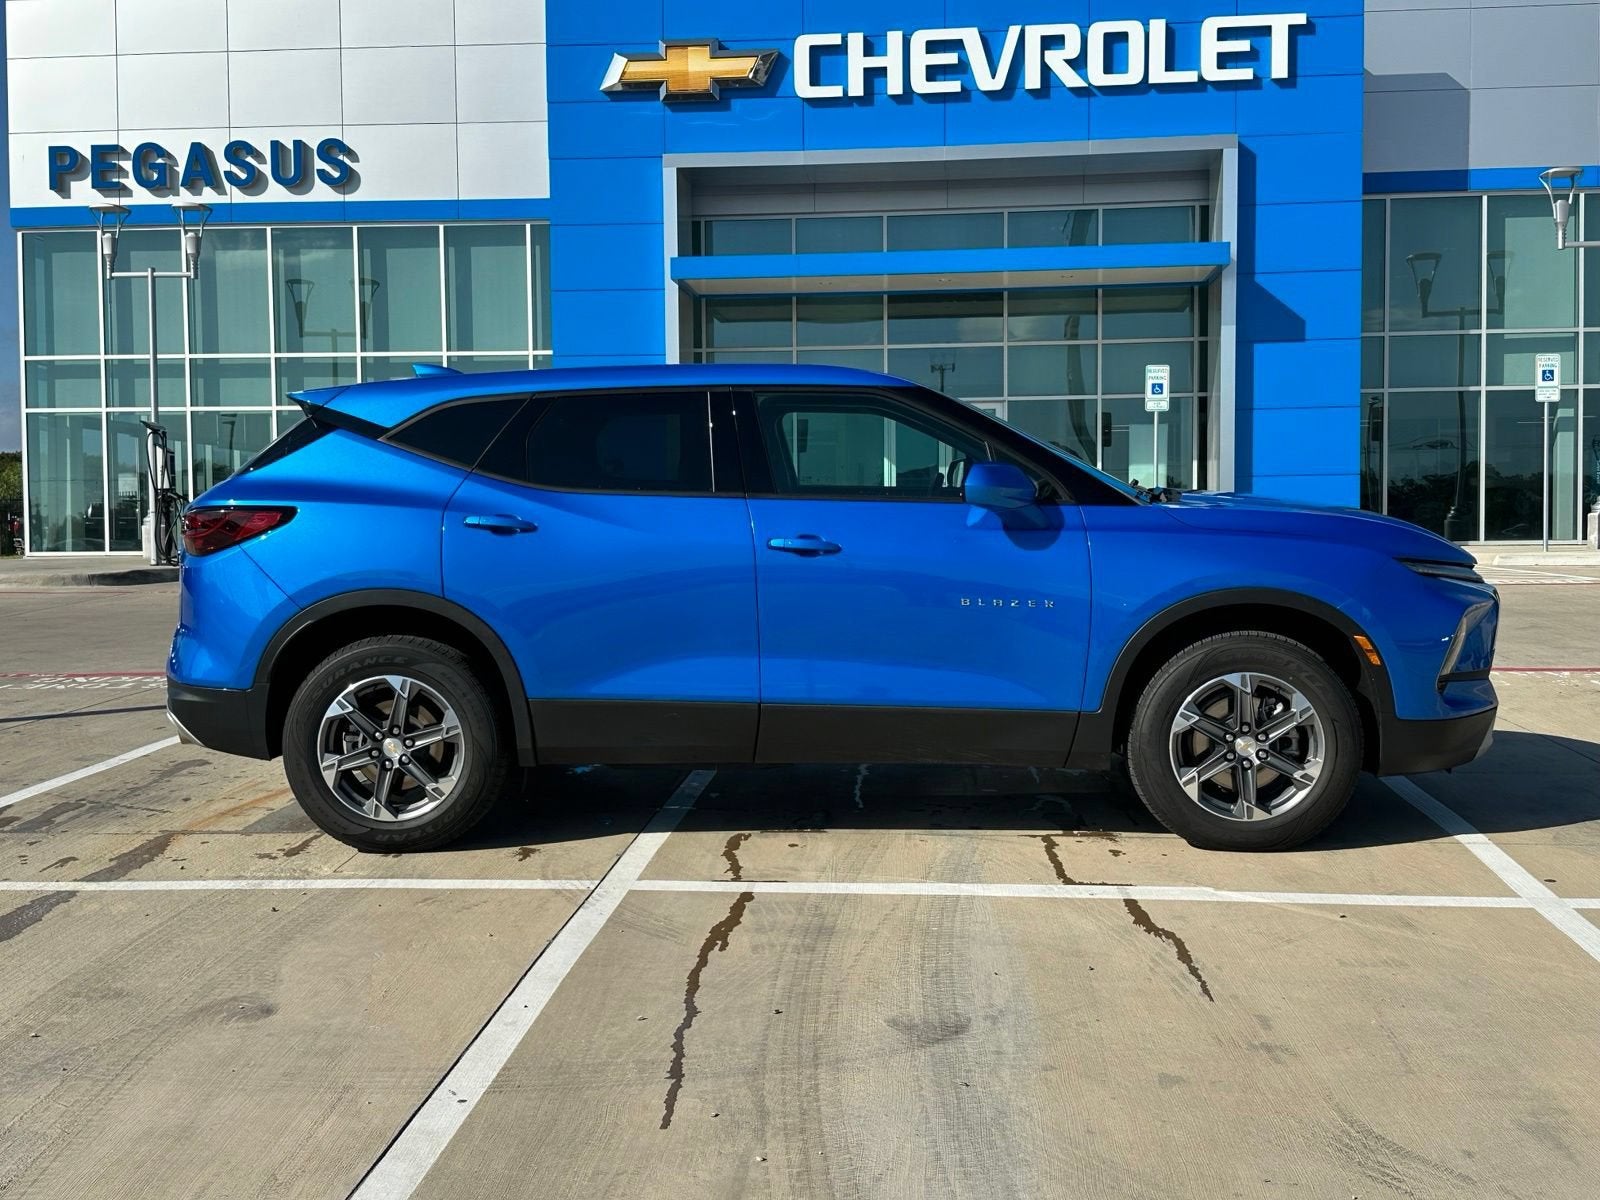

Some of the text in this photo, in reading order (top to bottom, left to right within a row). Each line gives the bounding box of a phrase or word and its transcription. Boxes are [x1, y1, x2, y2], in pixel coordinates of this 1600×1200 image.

[794, 13, 1307, 98] CHEVROLET
[48, 138, 350, 191] PEGASUS
[960, 598, 1055, 608] BLAZER
